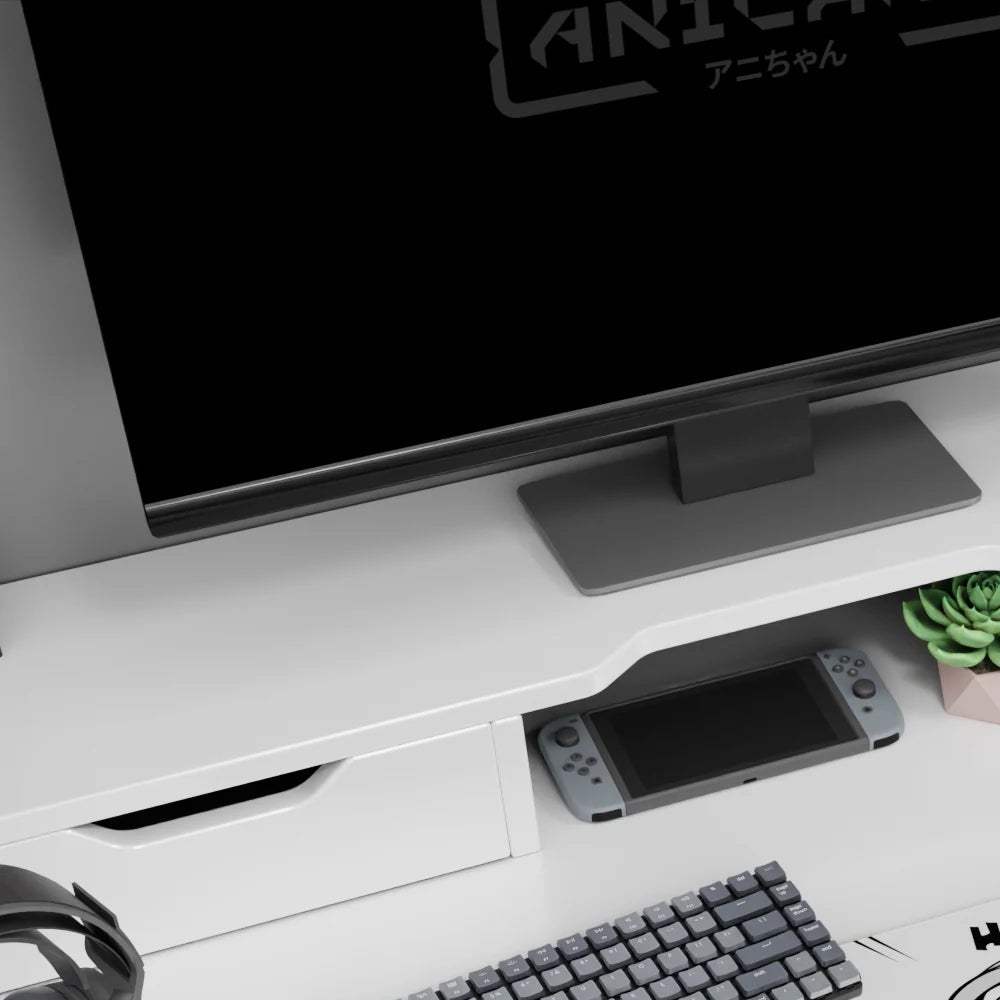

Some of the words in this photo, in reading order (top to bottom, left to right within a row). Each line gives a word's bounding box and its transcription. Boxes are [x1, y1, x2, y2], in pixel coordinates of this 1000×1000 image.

[706, 40, 847, 90] アニちゃん
